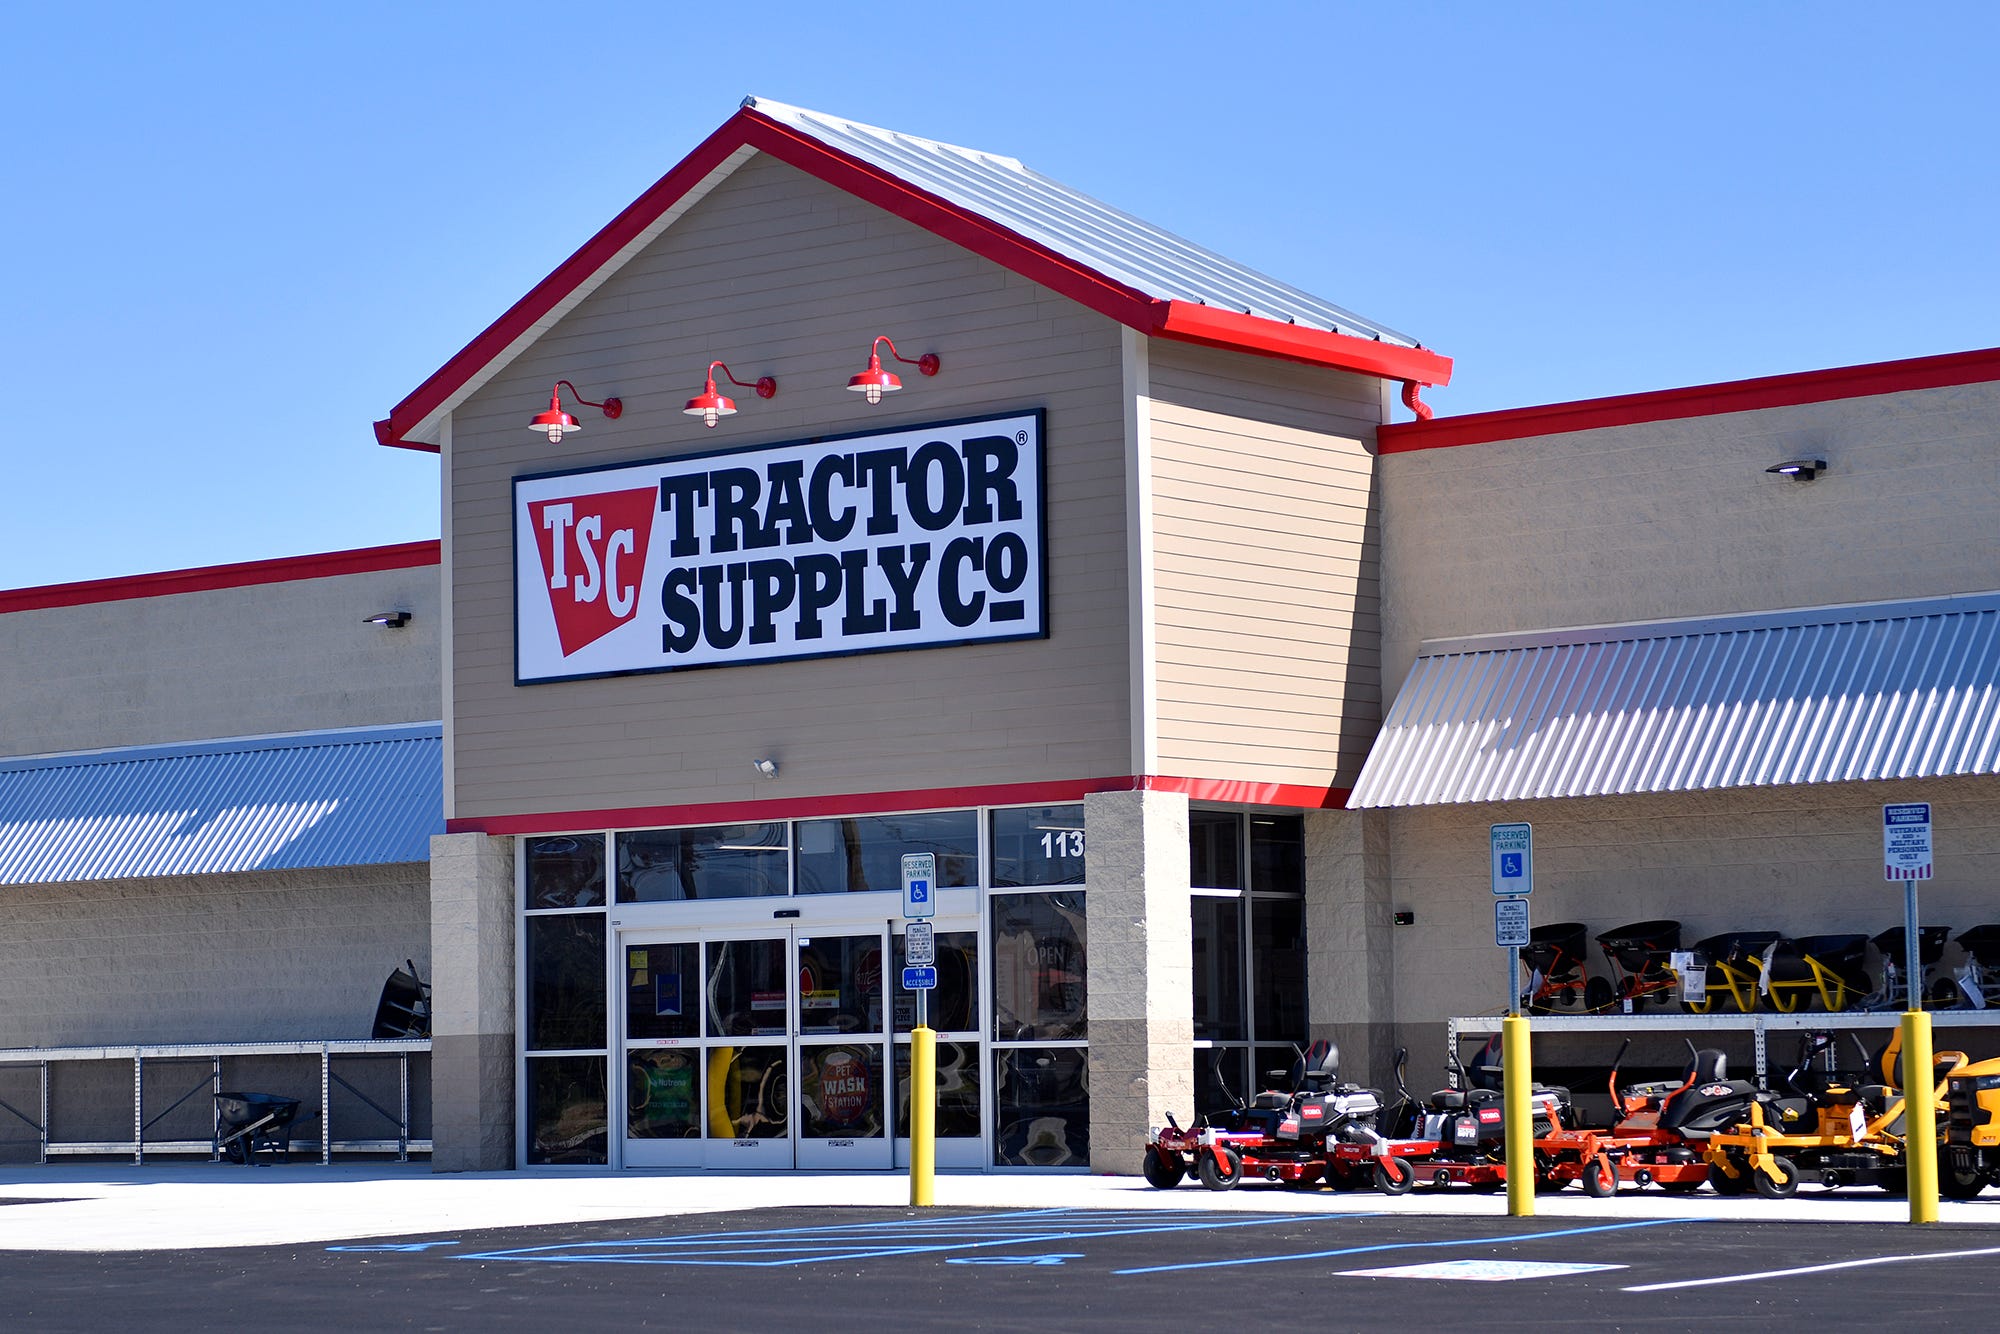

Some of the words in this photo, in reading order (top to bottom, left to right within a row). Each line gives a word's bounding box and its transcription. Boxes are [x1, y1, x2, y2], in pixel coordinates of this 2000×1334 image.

[660, 435, 1023, 558] TRACTOR
[543, 503, 634, 618] TSC
[661, 543, 931, 653] SUPPLY
[1493, 830, 1528, 840] RESERVED
[1496, 840, 1526, 850] PARKING
[904, 860, 932, 869] RESERVED
[906, 869, 931, 878] PARKING
[1027, 946, 1064, 966] OPEN
[905, 978, 934, 987] ACCESSIBLE
[836, 1065, 851, 1076] PET
[823, 1077, 865, 1095] WASH
[828, 1096, 862, 1108] STATION
